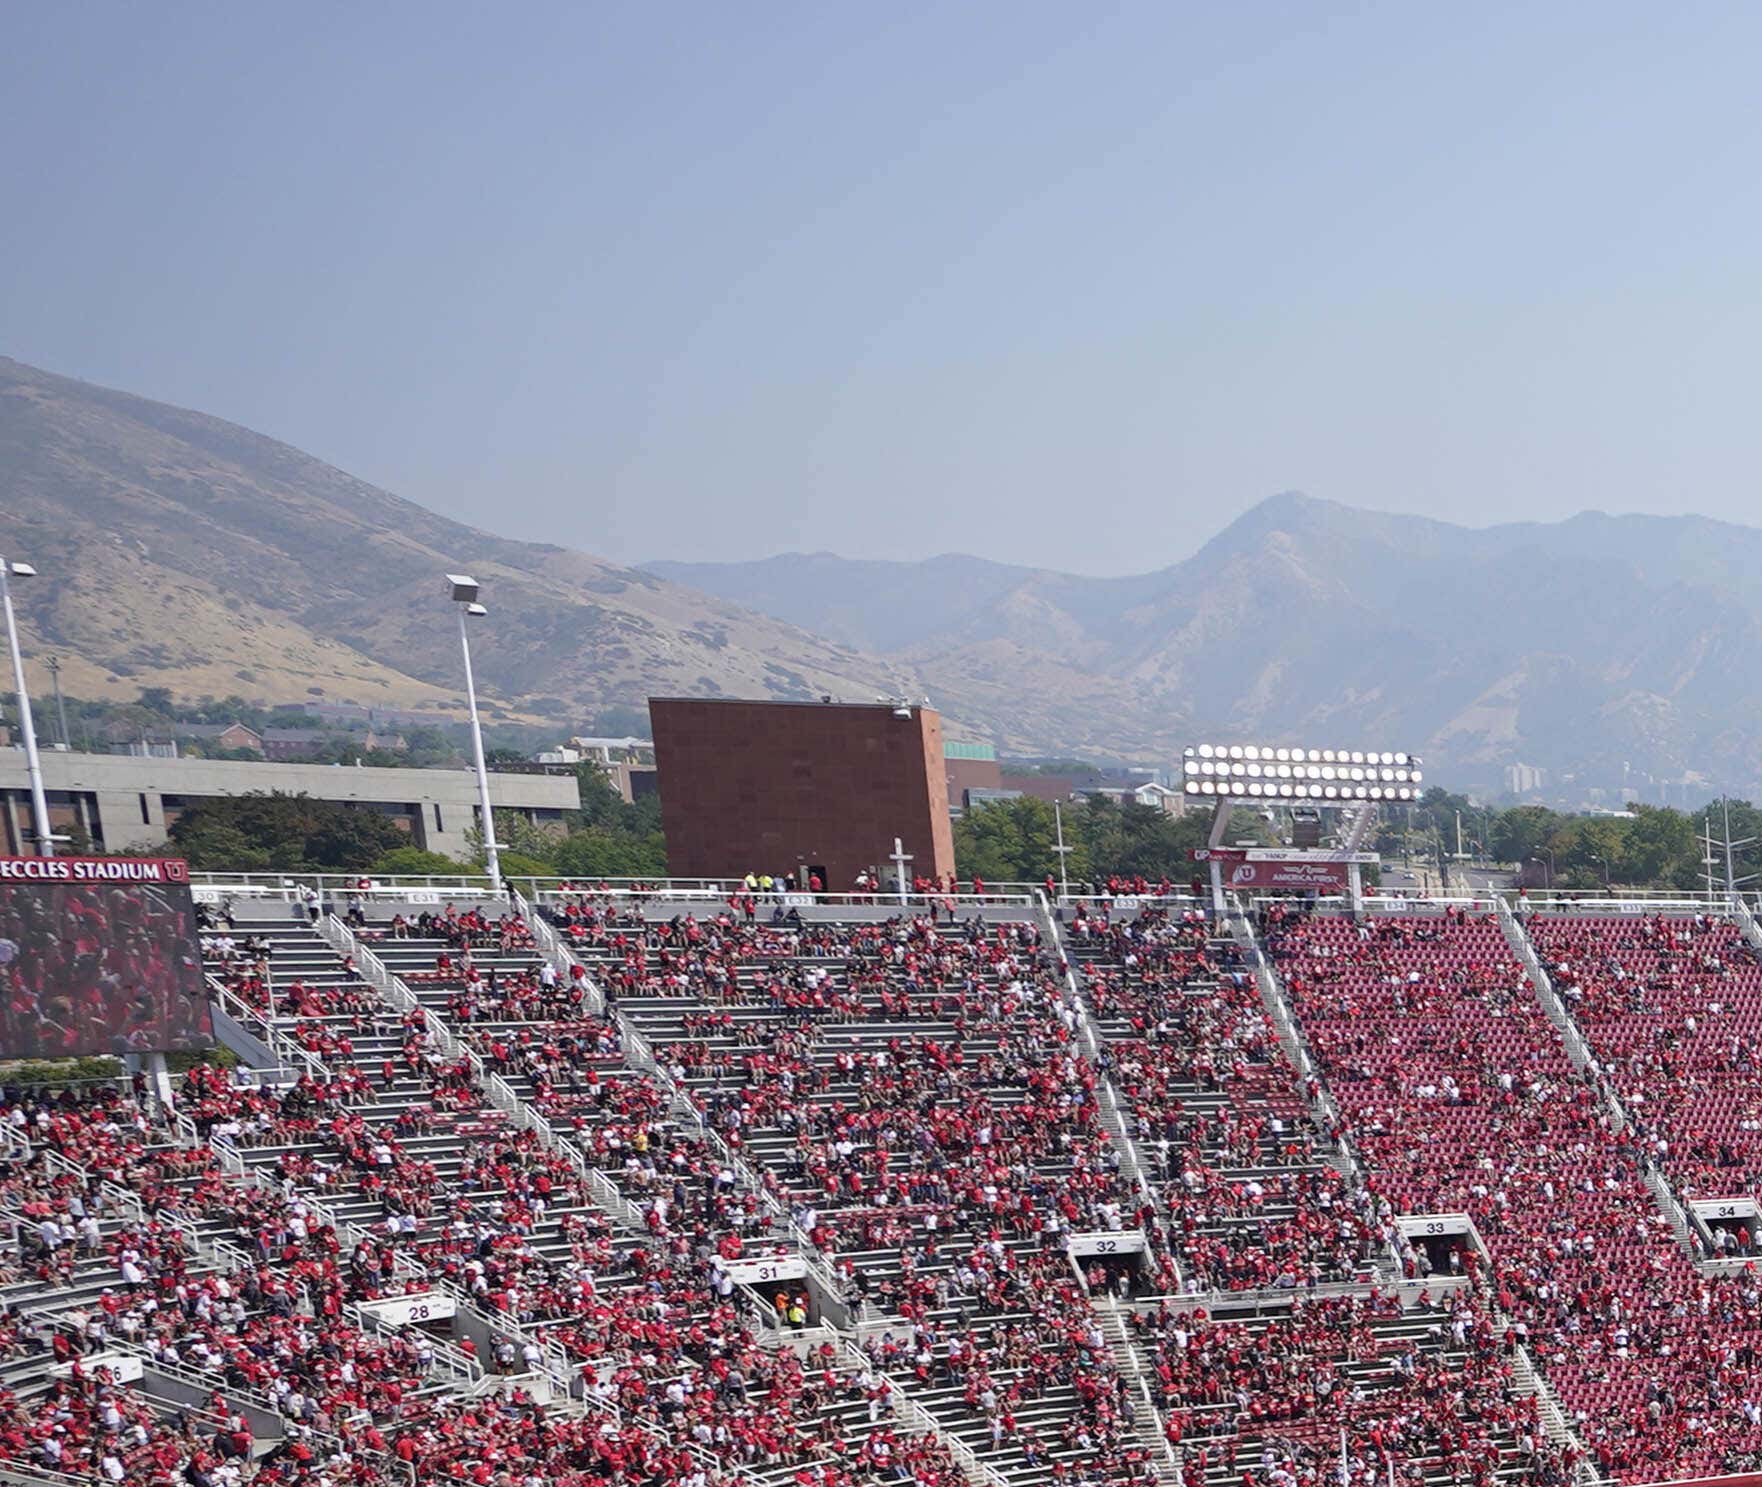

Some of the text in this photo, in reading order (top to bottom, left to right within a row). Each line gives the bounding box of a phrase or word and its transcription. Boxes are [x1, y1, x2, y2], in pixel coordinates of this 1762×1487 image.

[75, 861, 160, 879] STADIUM
[1719, 1205, 1735, 1217] 34
[1426, 1222, 1445, 1234] 33
[1096, 1240, 1117, 1253] 32
[759, 1264, 779, 1281] 31
[409, 1306, 430, 1321] 28
